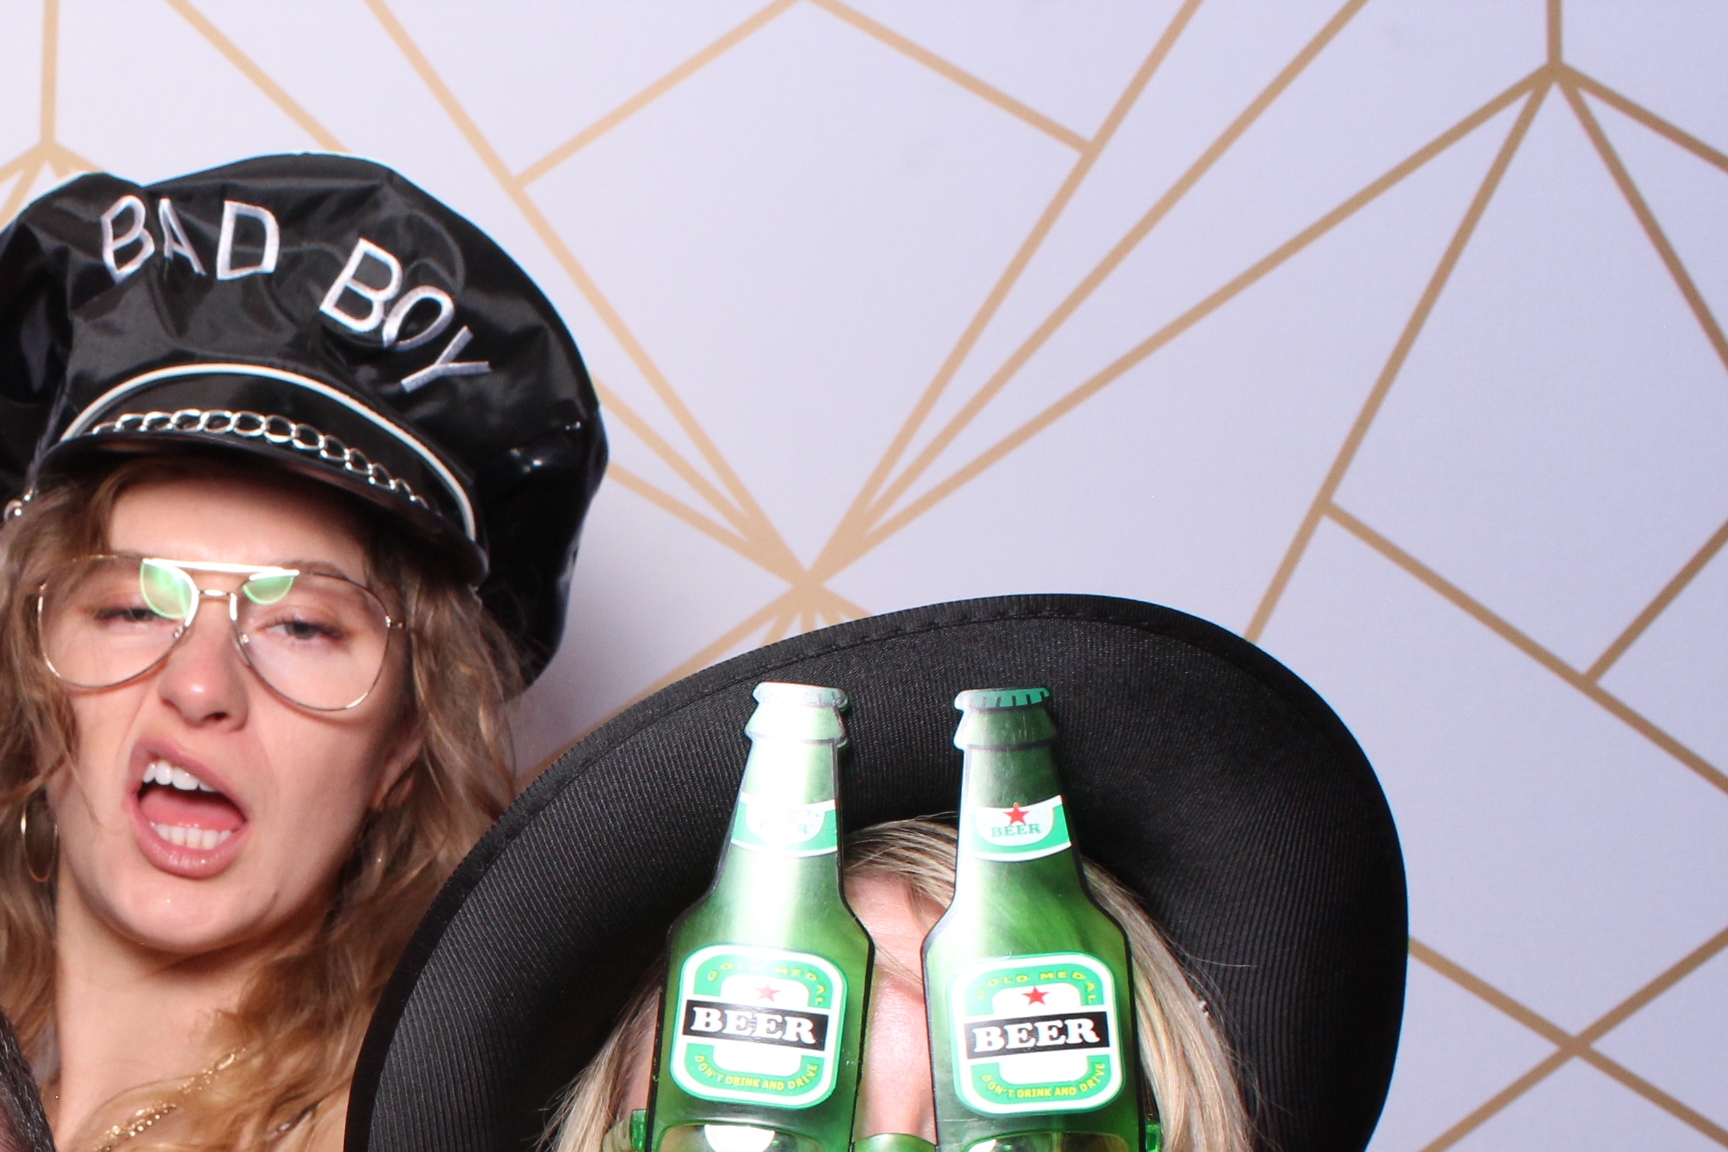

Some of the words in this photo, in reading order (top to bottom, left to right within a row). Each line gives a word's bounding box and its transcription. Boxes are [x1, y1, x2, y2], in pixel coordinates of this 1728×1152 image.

[100, 195, 281, 283] BAD
[319, 237, 491, 393] BOY
[991, 823, 1041, 837] BEER
[775, 966, 825, 1006] MEDAL
[1040, 971, 1096, 1005] MEDAL
[690, 1006, 816, 1044] BEER
[972, 1018, 1100, 1052] BEER
[693, 1055, 723, 1083] DON'T
[725, 1075, 760, 1088] DRINK
[762, 1080, 784, 1091] AND
[788, 1064, 818, 1090] DRIVE
[982, 1074, 1014, 1098] DON'T
[1016, 1088, 1052, 1098] DRINK
[1054, 1087, 1077, 1097] AND
[1079, 1063, 1106, 1093] DRIVE
